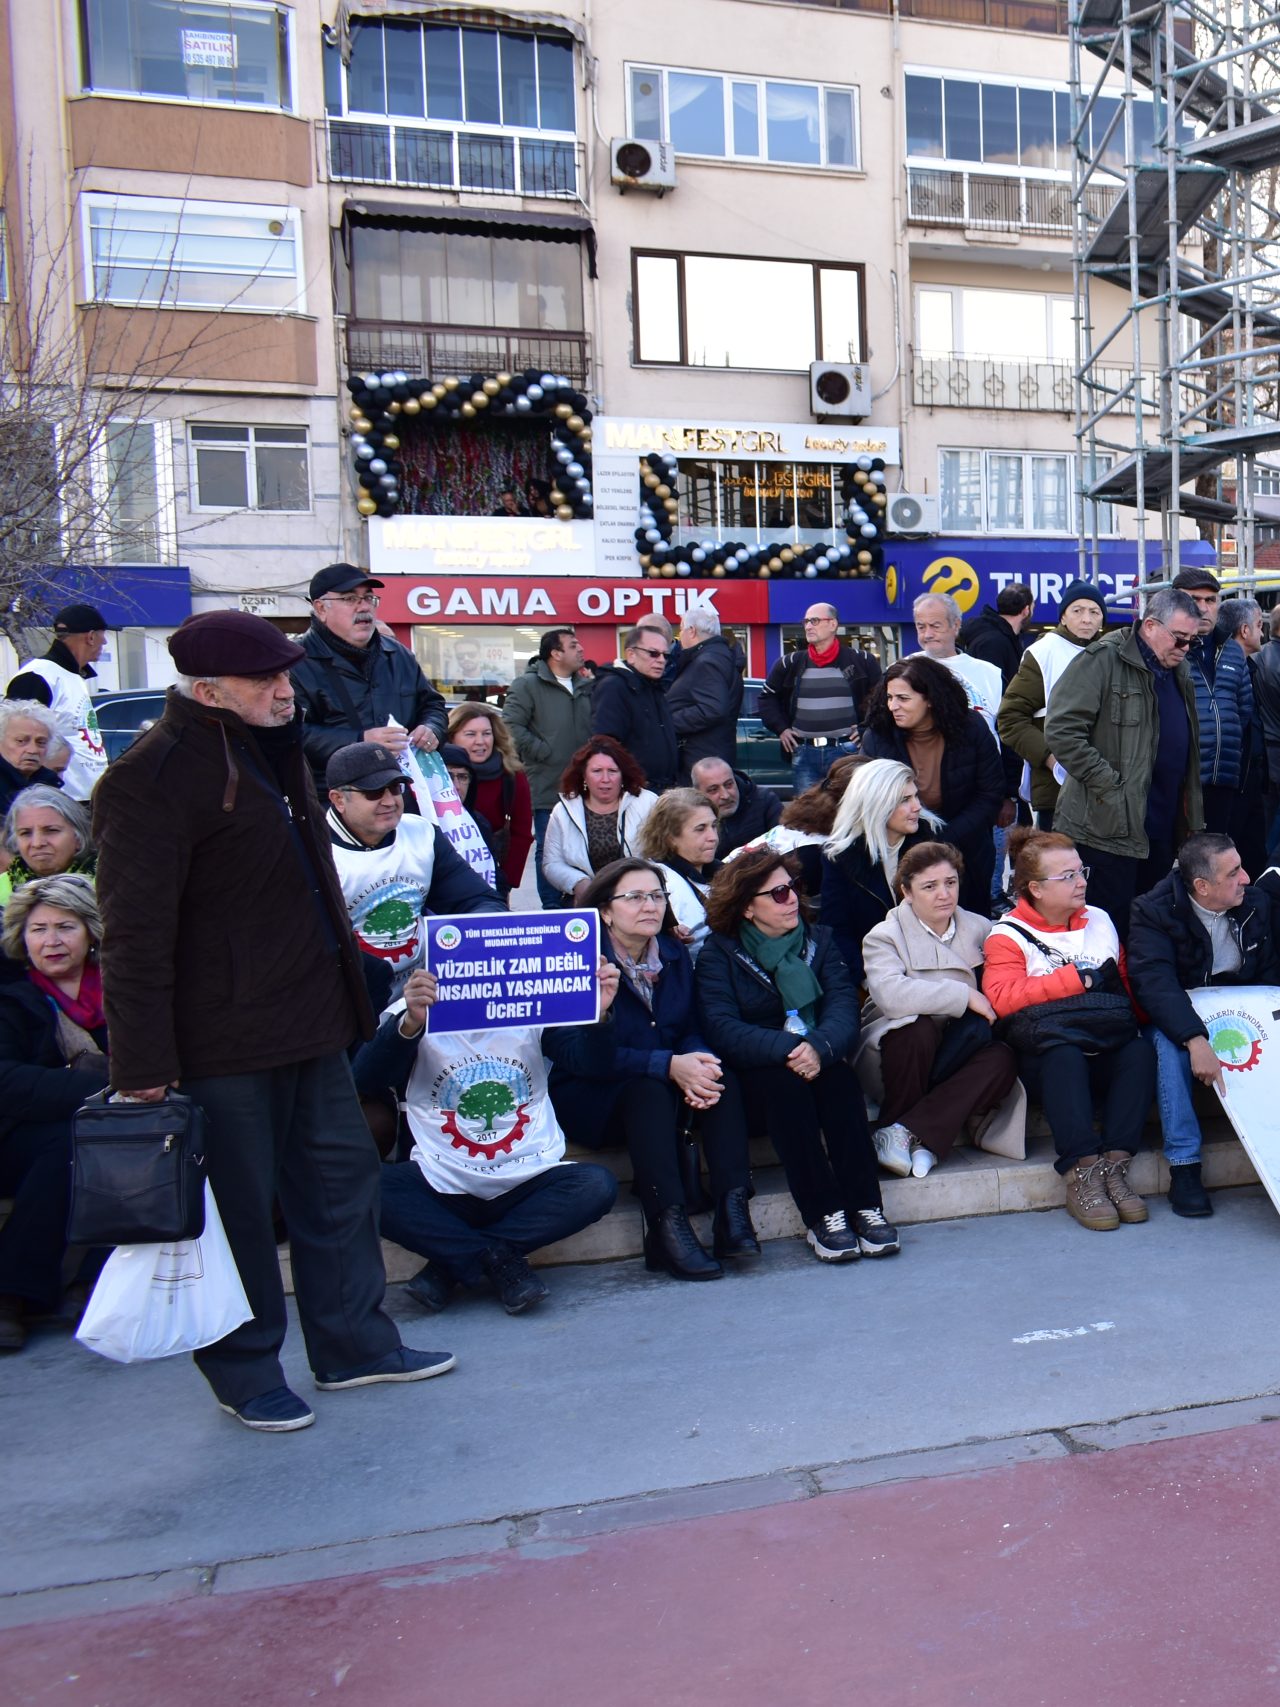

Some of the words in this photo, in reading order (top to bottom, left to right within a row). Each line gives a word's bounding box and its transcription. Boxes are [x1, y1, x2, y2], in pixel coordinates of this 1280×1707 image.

[185, 40, 232, 53] SATILIK
[407, 586, 557, 616] GAMA
[465, 928, 480, 938] TÜM
[481, 926, 525, 938] EMEKLİLERİN
[526, 925, 561, 935] SENDİKASI
[484, 939, 518, 947] MUDANYA
[518, 935, 543, 947] ŞUBESİ
[436, 957, 506, 979] YÜZDELİK
[509, 957, 541, 975] ZAM
[546, 952, 590, 972] DEĞİL,
[506, 976, 592, 998] YAŞANACAK
[486, 1001, 533, 1020] ÜCRET
[536, 1001, 542, 1016] !
[1203, 1009, 1235, 1025] KLİLERİN
[476, 1132, 497, 1142] 2017
